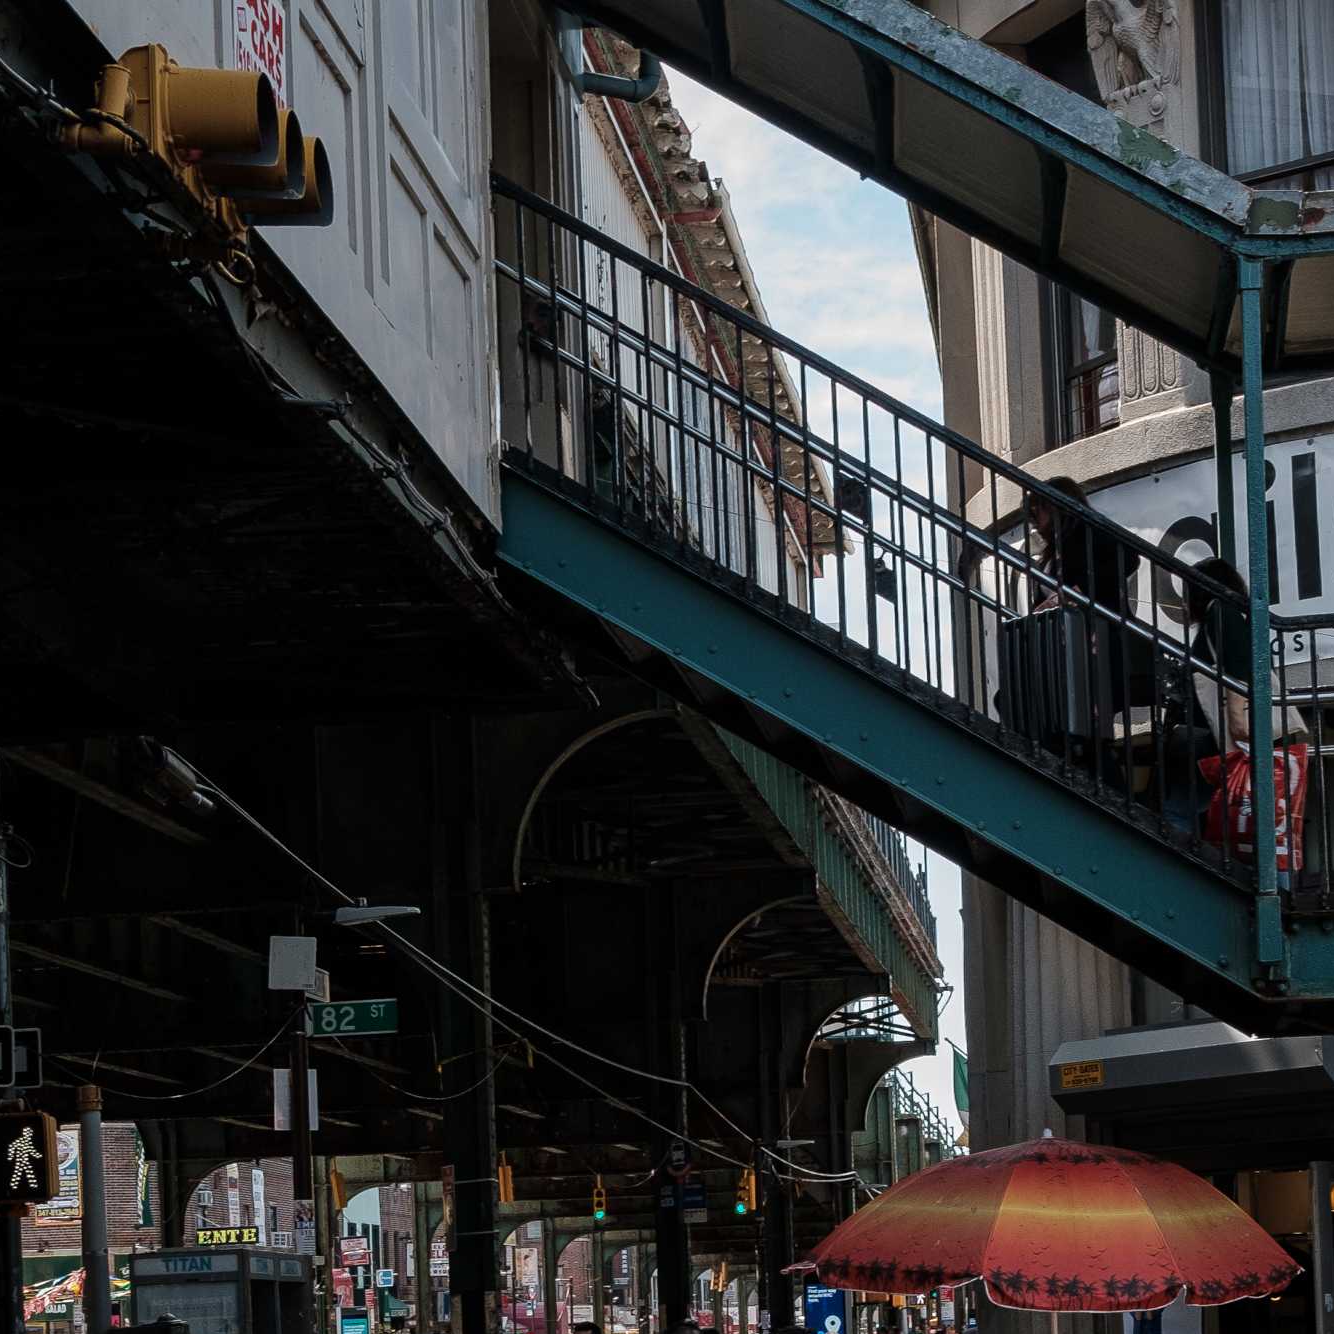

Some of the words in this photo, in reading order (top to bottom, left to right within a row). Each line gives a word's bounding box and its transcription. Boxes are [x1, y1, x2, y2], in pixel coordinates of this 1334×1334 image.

[321, 1007, 356, 1031] 82
[370, 1004, 386, 1018] ST
[162, 1256, 212, 1272] TITAN
